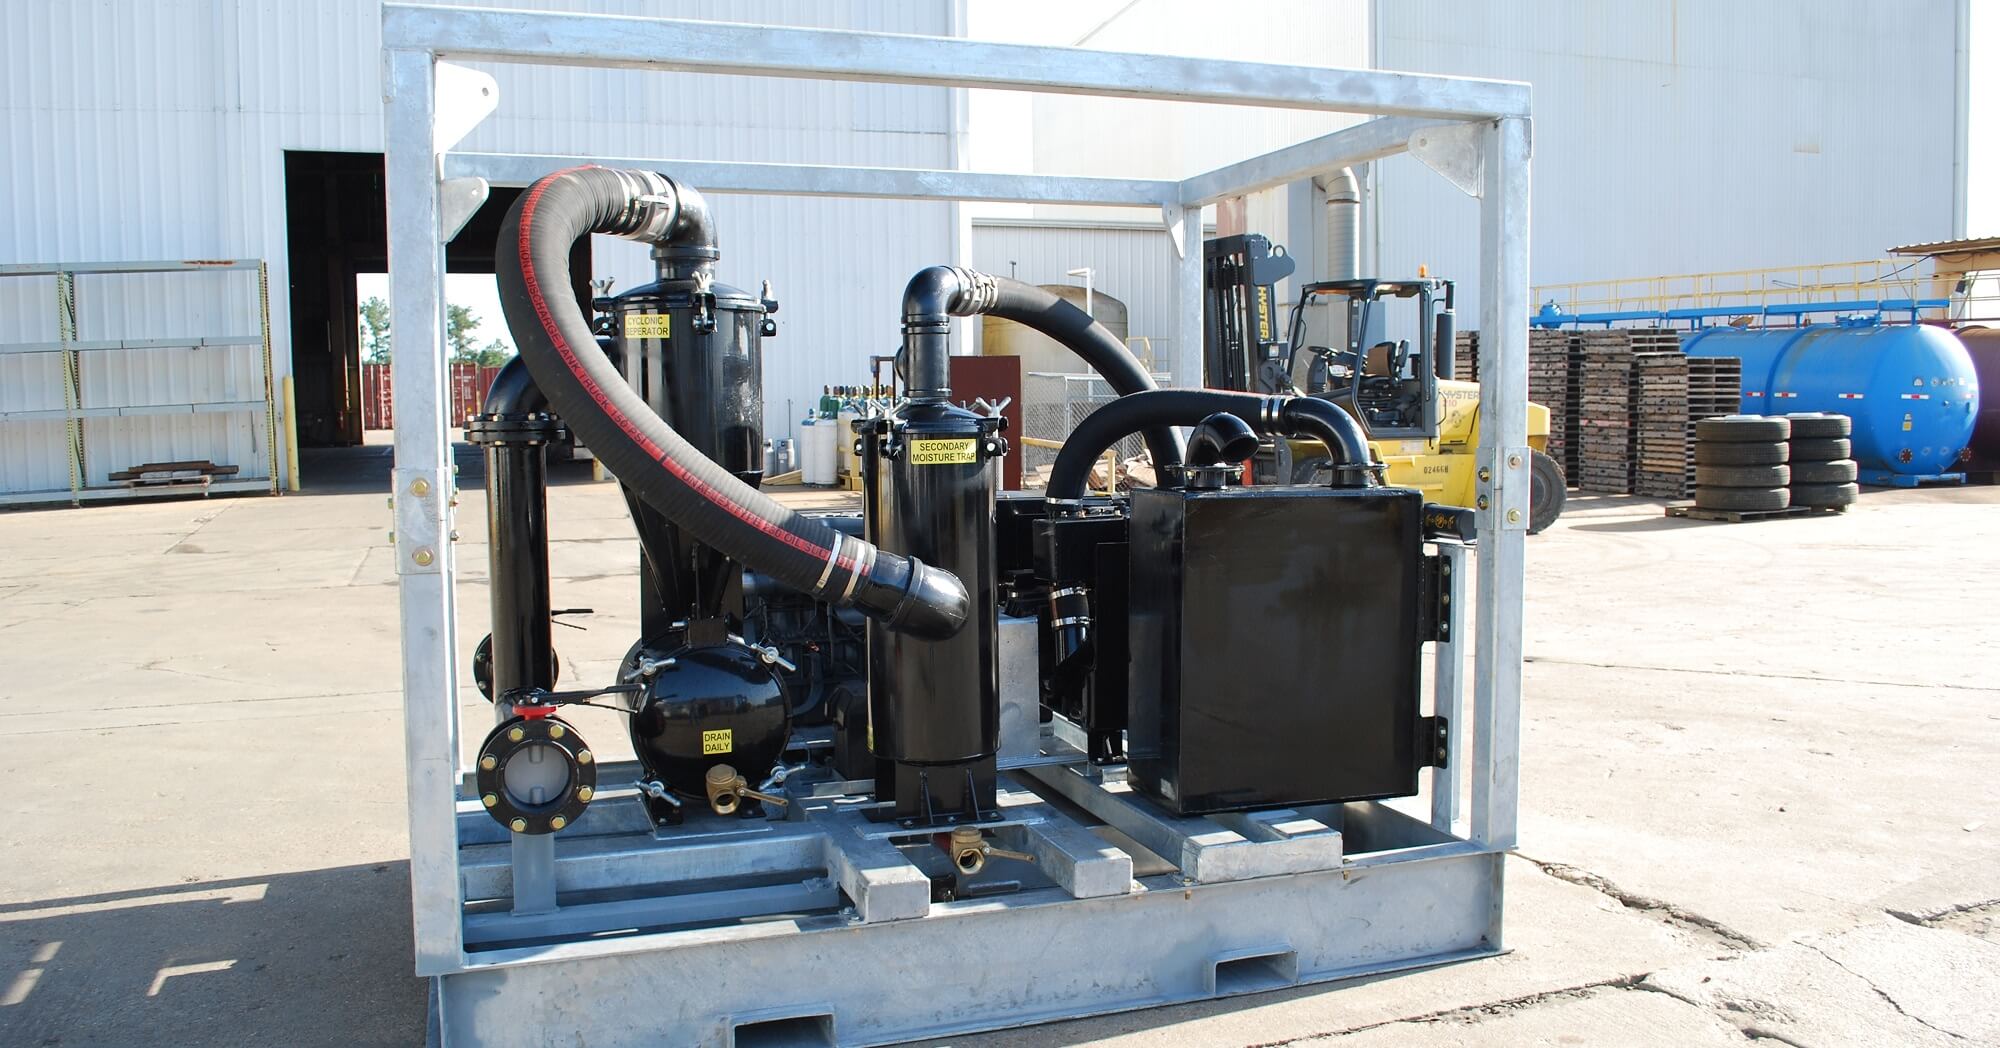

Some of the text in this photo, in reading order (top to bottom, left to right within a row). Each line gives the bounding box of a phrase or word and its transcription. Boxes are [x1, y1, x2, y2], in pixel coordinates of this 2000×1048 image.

[1257, 286, 1269, 339] HYSTER
[627, 316, 663, 325] CYCLONIC
[626, 327, 668, 336] SEPERATOR
[526, 276, 562, 344] DISCHARGE
[557, 343, 581, 373] TANK
[578, 373, 611, 409] TRUCK
[611, 410, 629, 428] 150
[628, 426, 648, 445] PSI
[919, 442, 969, 451] SECONDARY
[912, 452, 975, 462] MOISTURE TRAP
[734, 506, 761, 526] TYPE
[784, 533, 801, 548] OIL
[704, 732, 731, 742] DRAIN
[705, 742, 730, 752] DAILY
